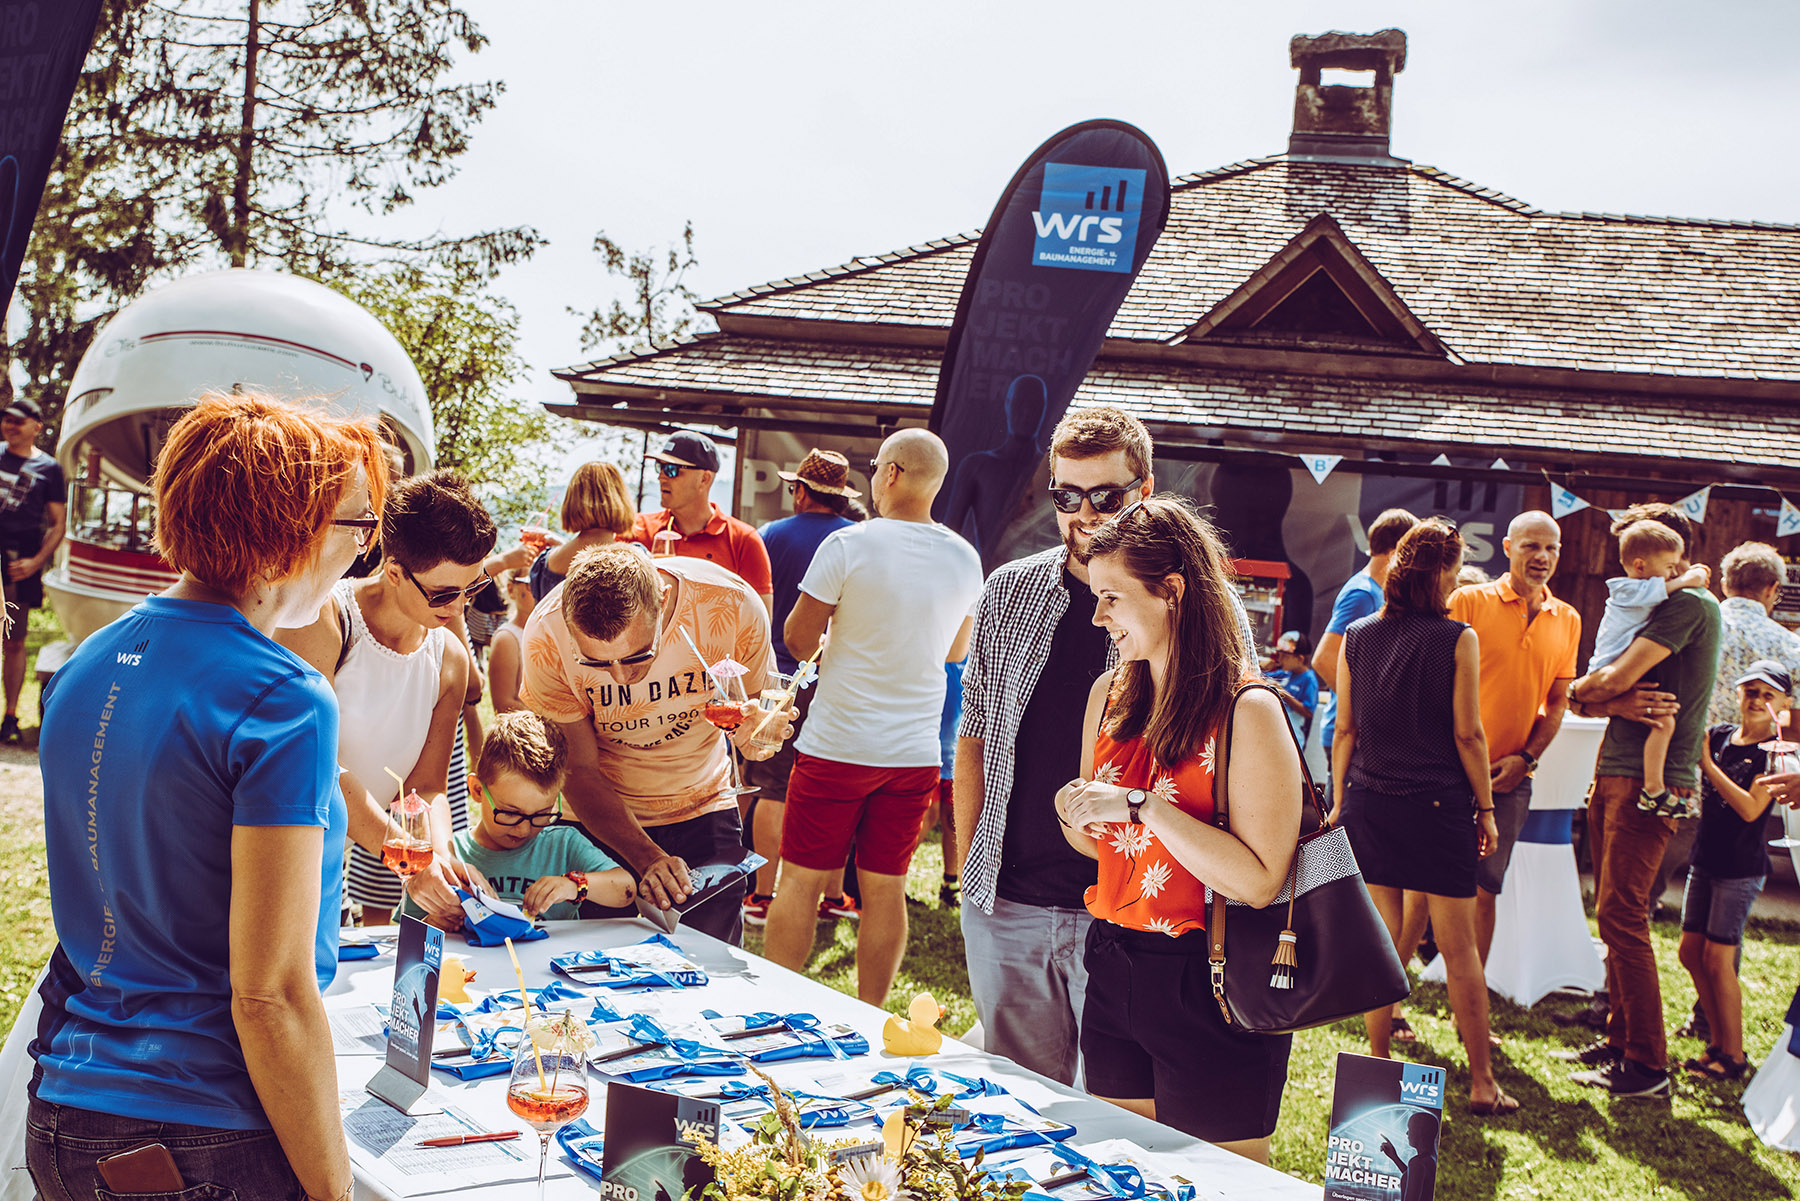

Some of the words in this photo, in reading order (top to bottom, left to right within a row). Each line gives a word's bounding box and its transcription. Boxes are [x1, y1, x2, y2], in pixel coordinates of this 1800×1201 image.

[0, 2, 39, 47] RO
[1032, 211, 1122, 244] wrs
[1039, 253, 1117, 266] BAUMANAGEMENT
[979, 278, 1051, 311] PRO
[968, 311, 1069, 343] JEKT
[972, 340, 1073, 375] MACH
[1315, 460, 1326, 472] B
[116, 652, 142, 667] wrs
[585, 684, 632, 707] SUN
[598, 718, 650, 732] TOUR
[424, 941, 440, 958] wrs
[392, 990, 407, 1007] PRO
[1399, 1080, 1438, 1097] wrs
[1328, 1135, 1364, 1153] PRO
[1328, 1151, 1373, 1170] JEKT
[1325, 1165, 1401, 1191] MACHER
[601, 1180, 639, 1201] PRO
